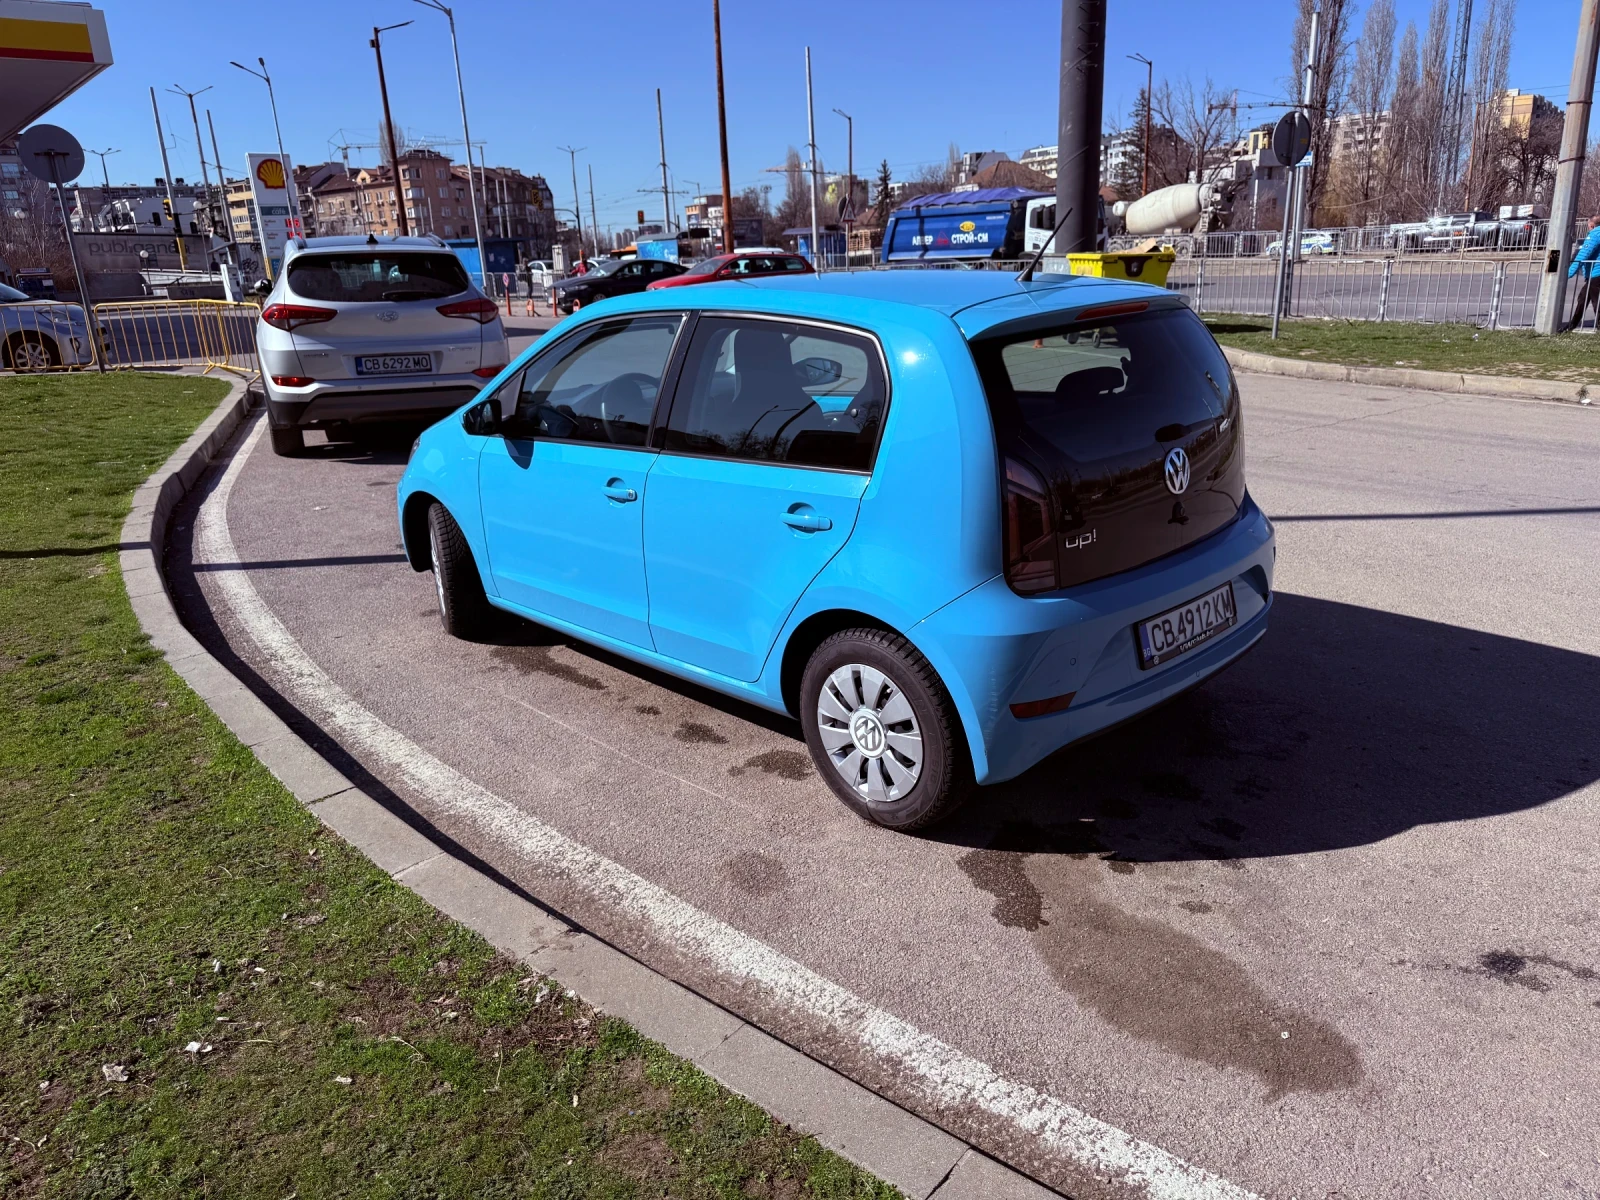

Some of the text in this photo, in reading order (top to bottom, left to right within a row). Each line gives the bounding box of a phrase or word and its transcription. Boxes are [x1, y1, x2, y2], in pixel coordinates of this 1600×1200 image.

[364, 356, 428, 370] CB 6292 MO
[1164, 447, 1191, 495] VW
[1065, 528, 1097, 549] up!
[1151, 589, 1233, 652] CB 4912 KM
